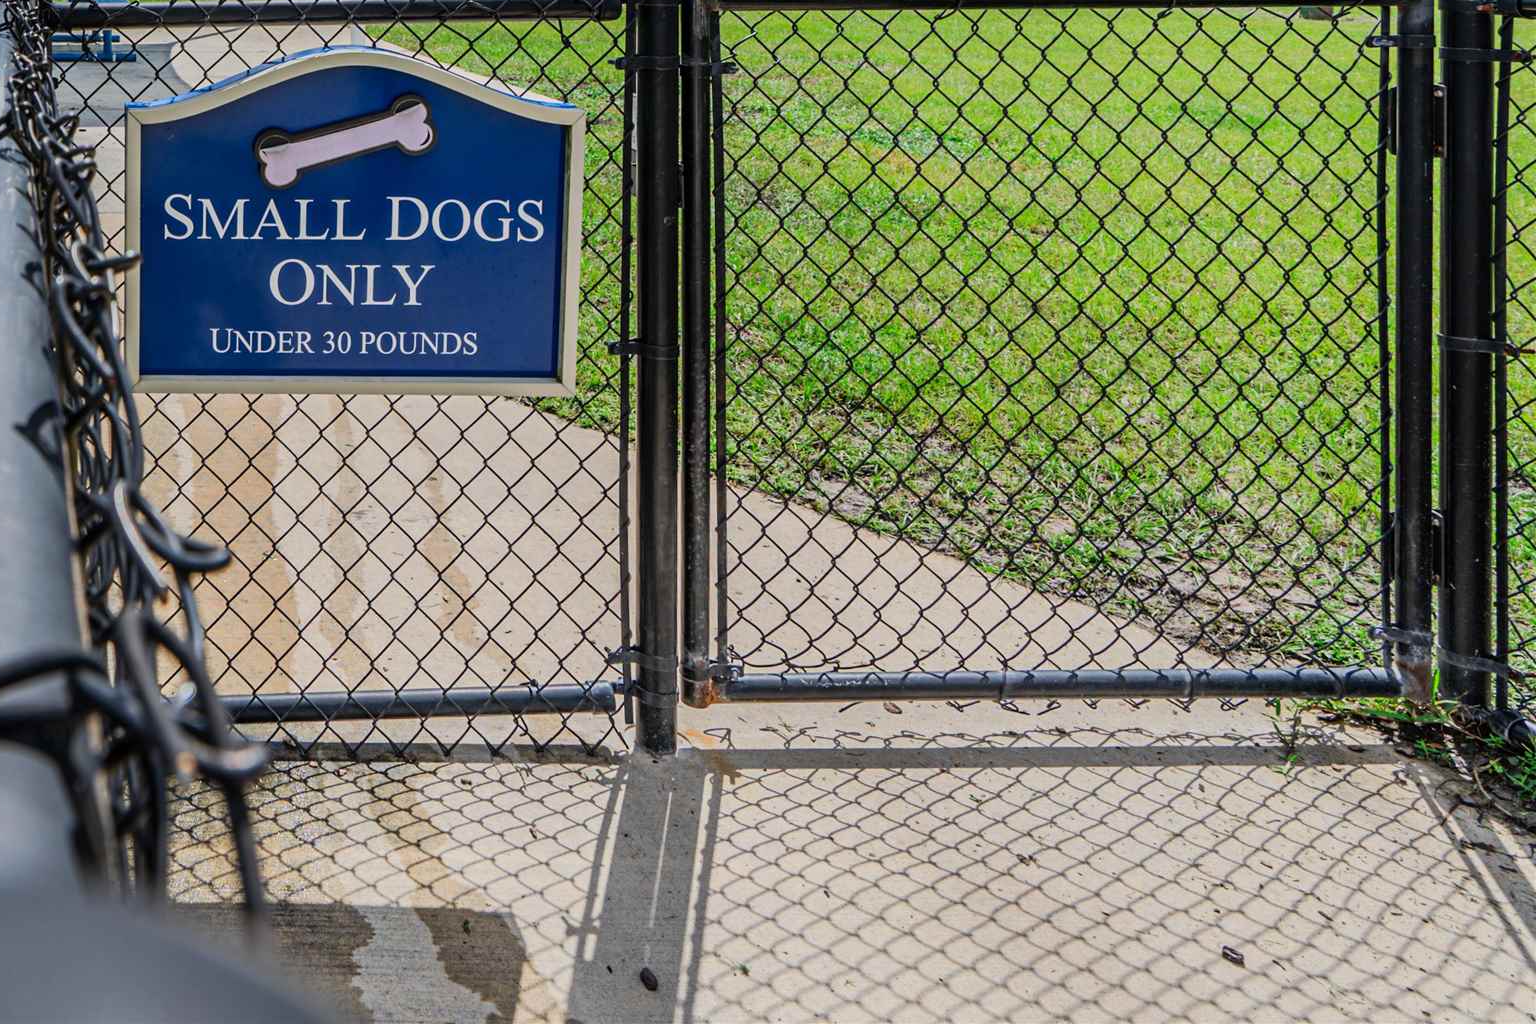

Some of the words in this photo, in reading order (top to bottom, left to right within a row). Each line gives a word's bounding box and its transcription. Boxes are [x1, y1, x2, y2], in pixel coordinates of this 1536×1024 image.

[164, 193, 367, 241] SMALL
[385, 196, 545, 242] DOGS
[269, 258, 436, 306] ONLY
[209, 327, 315, 354] UNDER
[322, 330, 352, 354] 30
[359, 331, 478, 356] POUNDS
